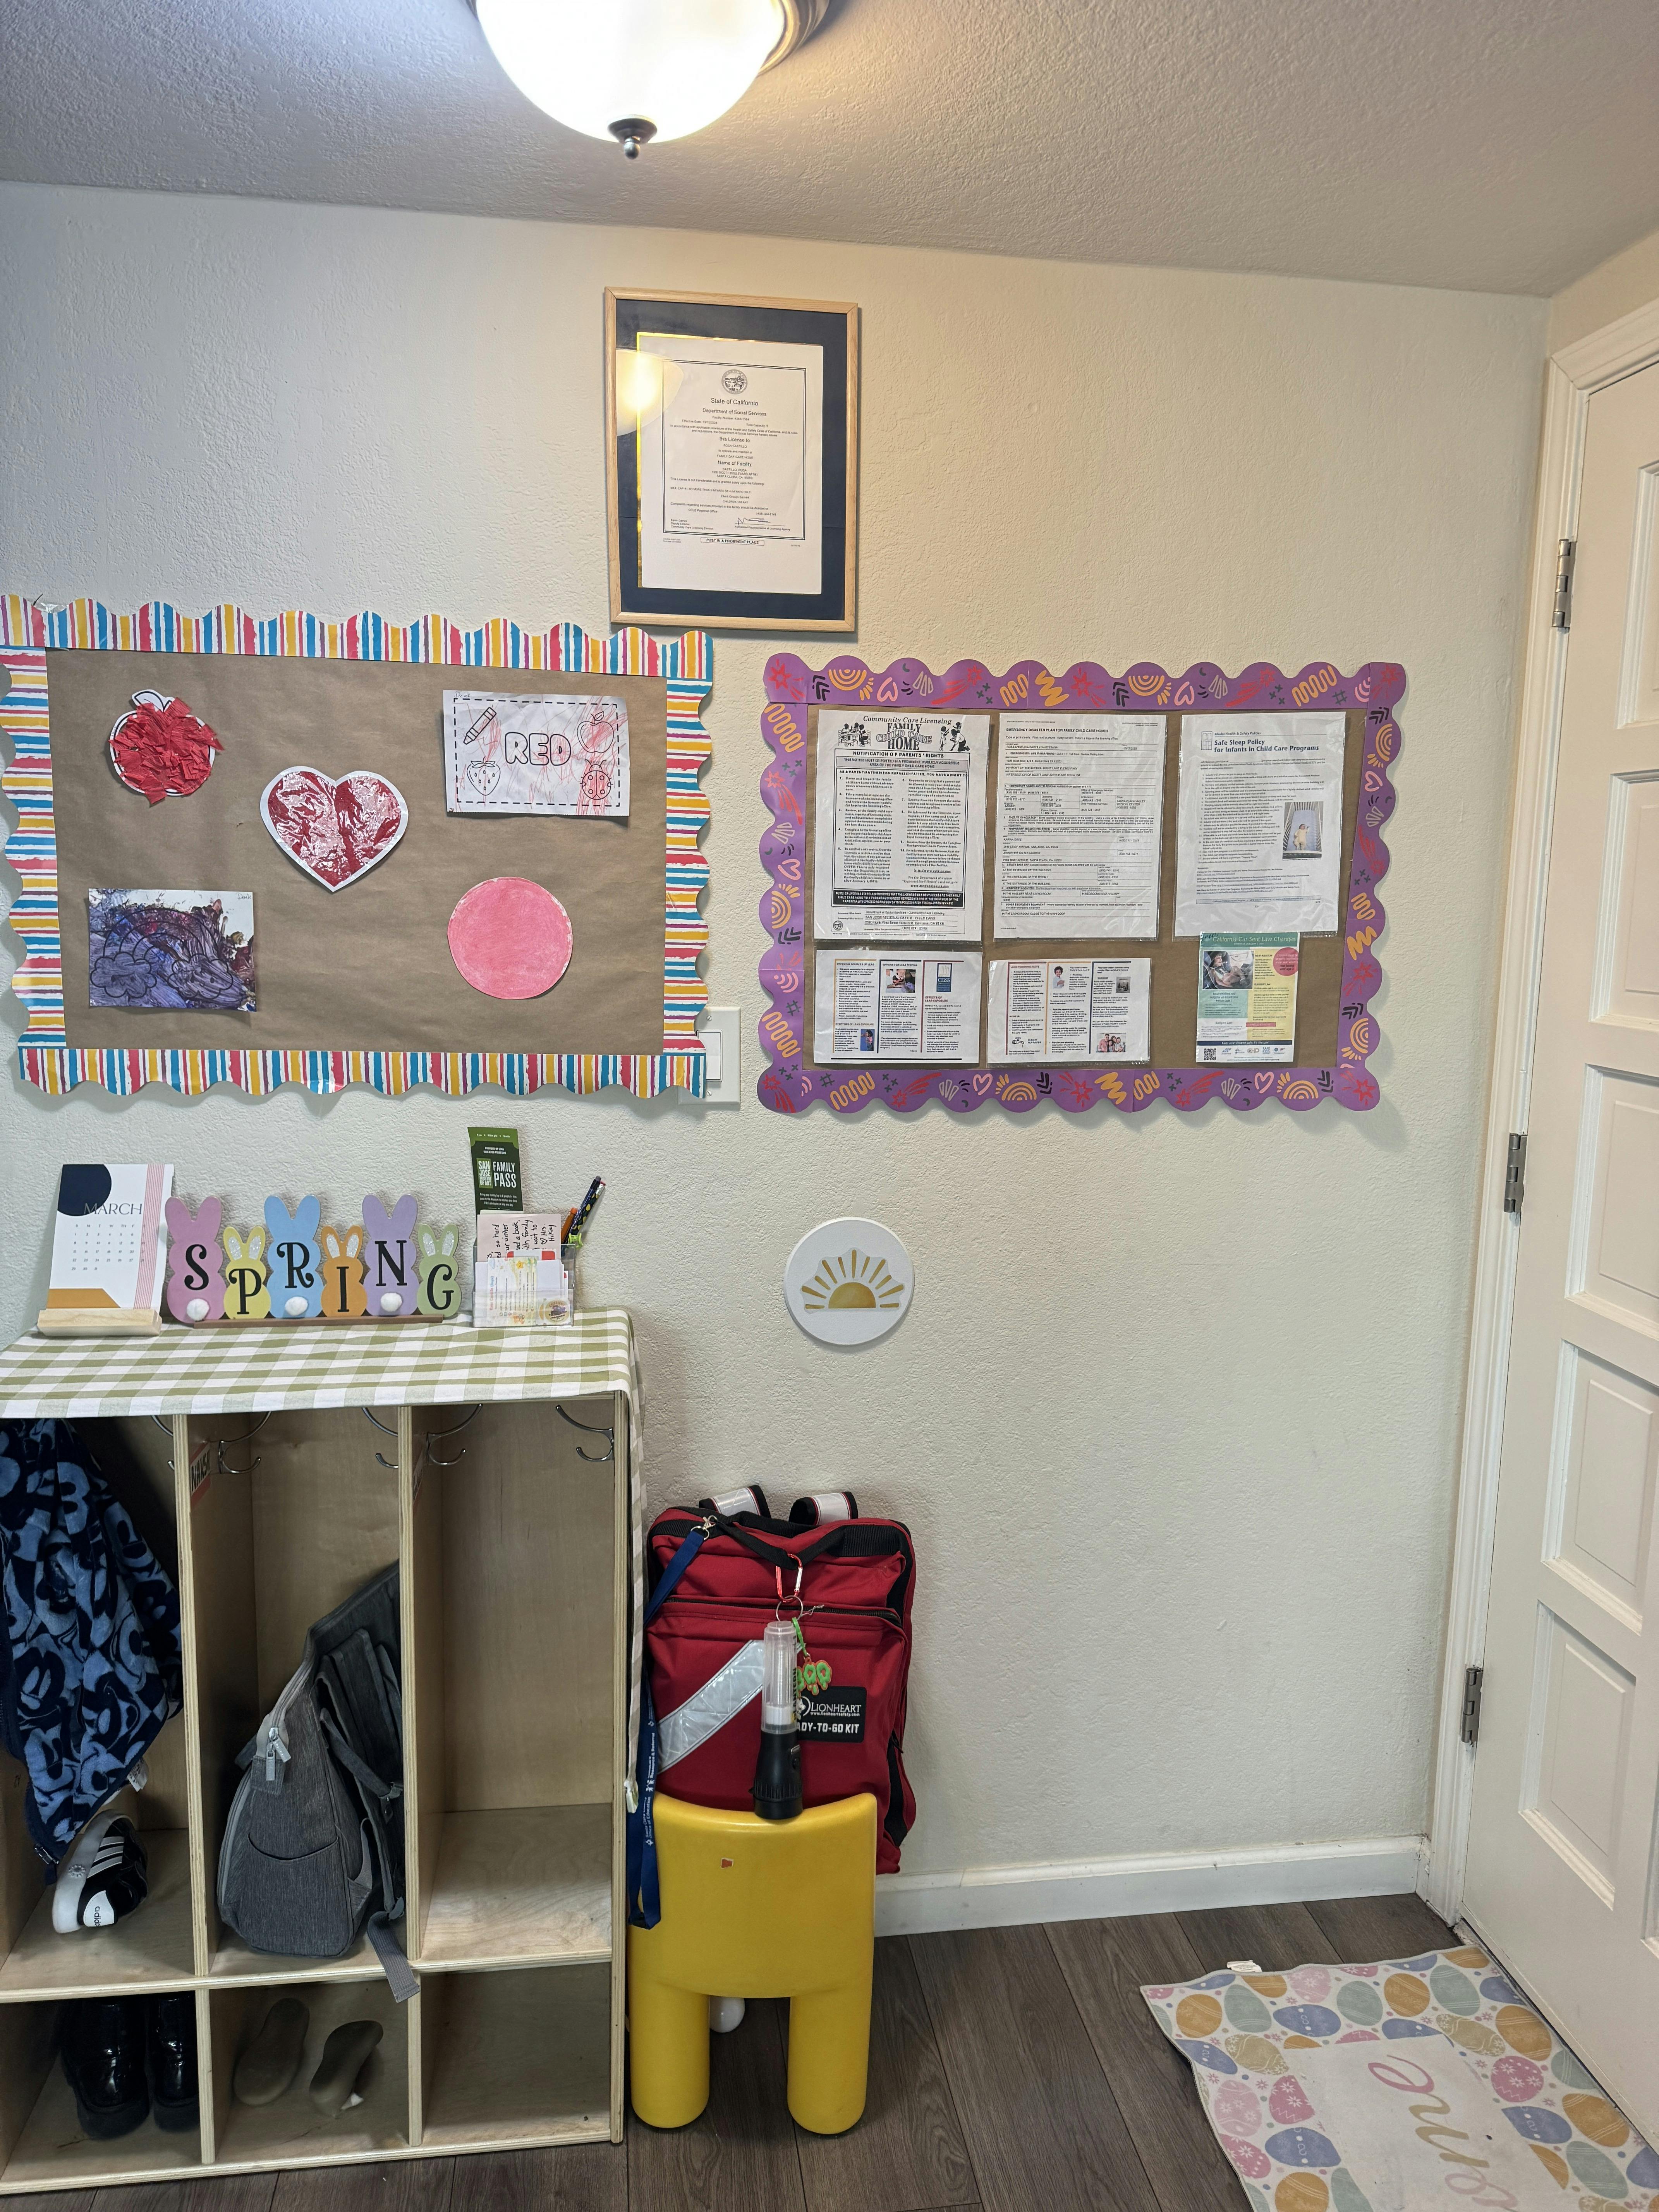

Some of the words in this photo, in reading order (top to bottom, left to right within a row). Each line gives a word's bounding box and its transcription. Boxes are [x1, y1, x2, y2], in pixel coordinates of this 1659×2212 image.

[887, 723, 922, 733] FAMILY
[876, 730, 905, 742] CHILD
[908, 731, 932, 744] CARE
[888, 737, 919, 750] HOME
[505, 732, 571, 766] RED
[478, 1161, 490, 1170] SAN
[493, 1161, 515, 1172] FAMILY
[494, 1173, 517, 1188] PASS
[84, 1202, 143, 1215] MARCH
[512, 1220, 520, 1234] book,
[521, 1220, 533, 1237] family
[548, 1225, 557, 1241] McKay
[184, 1240, 454, 1315] SPRING
[811, 1702, 862, 1712] LIONHEART
[797, 1722, 843, 1733] ADY-TO-GO
[846, 1724, 859, 1734] KIT
[1368, 2054, 1518, 2212] ome
